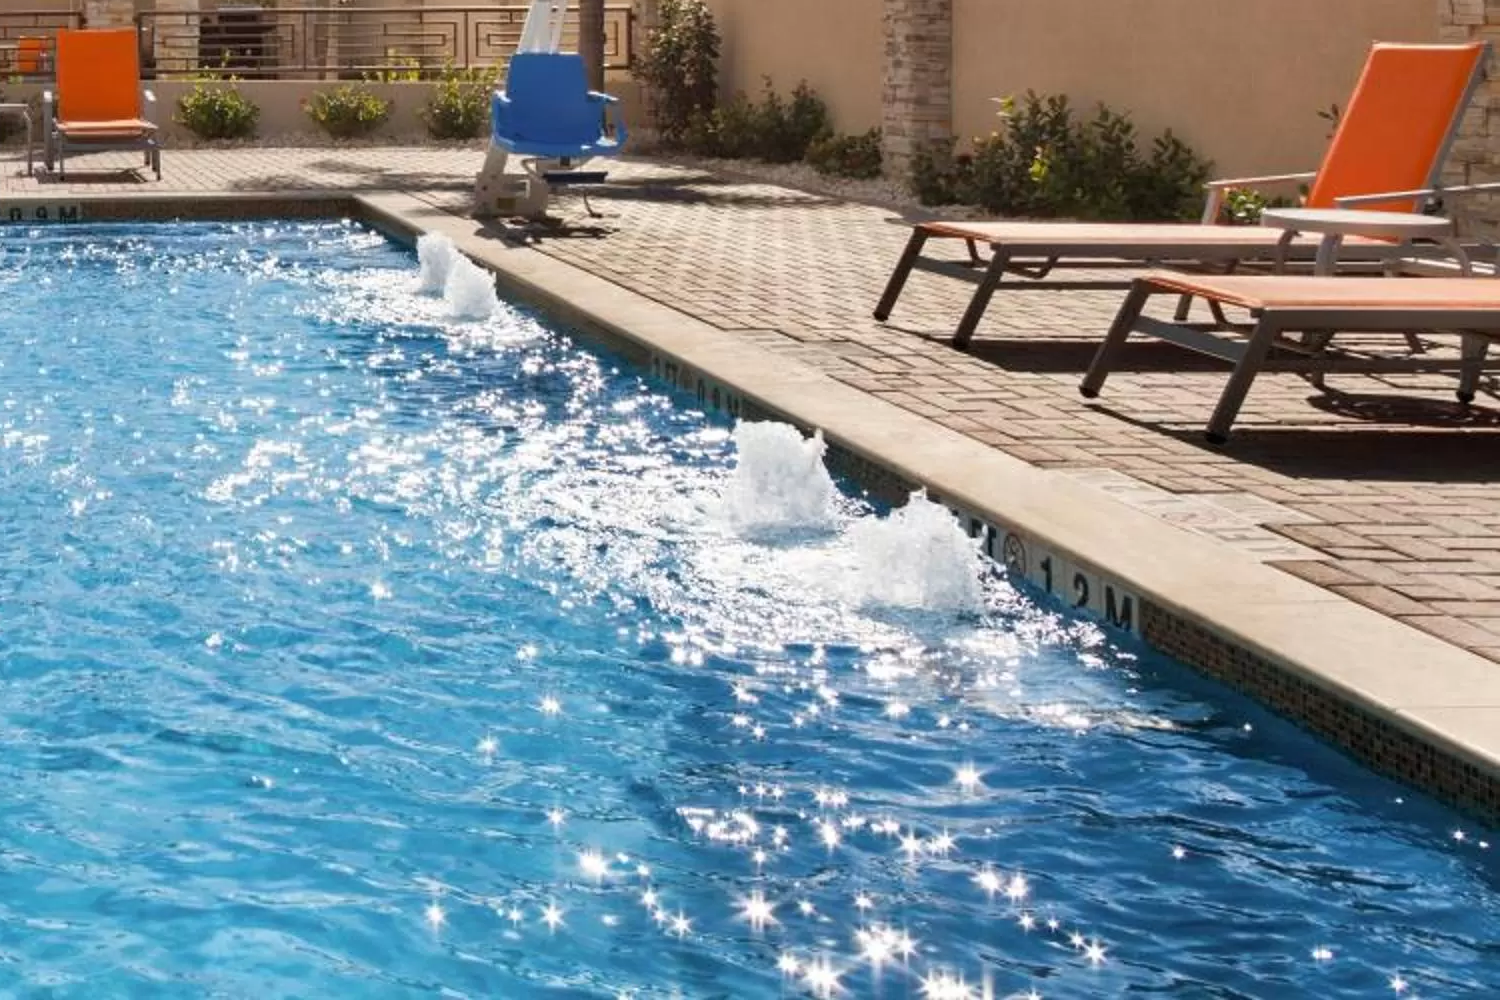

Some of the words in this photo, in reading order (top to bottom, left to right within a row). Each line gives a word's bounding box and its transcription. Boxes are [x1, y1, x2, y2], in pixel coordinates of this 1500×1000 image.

[59, 206, 78, 224] M
[1040, 557, 1053, 594] 1
[1105, 584, 1134, 632] M
